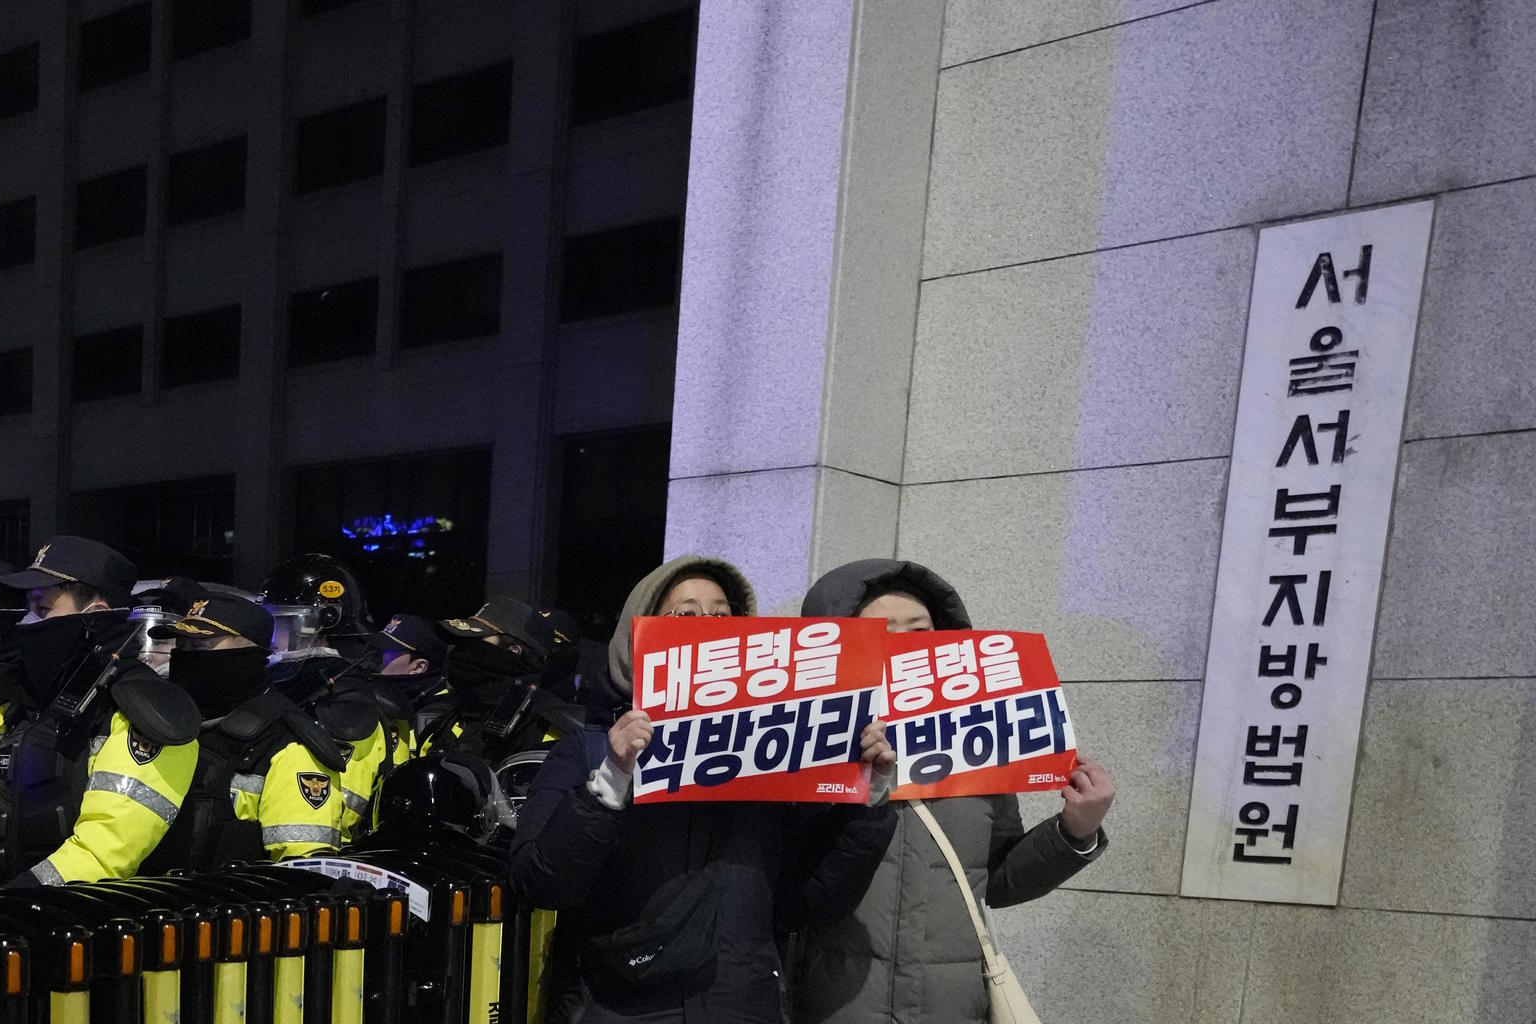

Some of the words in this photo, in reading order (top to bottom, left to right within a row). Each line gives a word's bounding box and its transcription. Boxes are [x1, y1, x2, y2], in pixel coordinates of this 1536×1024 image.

[1232, 244, 1373, 866] 서울서부지방법원
[641, 622, 842, 713] 대통령을
[880, 634, 1024, 718] 통령을
[637, 689, 877, 794] 석방하라
[891, 690, 1067, 787] 방하라
